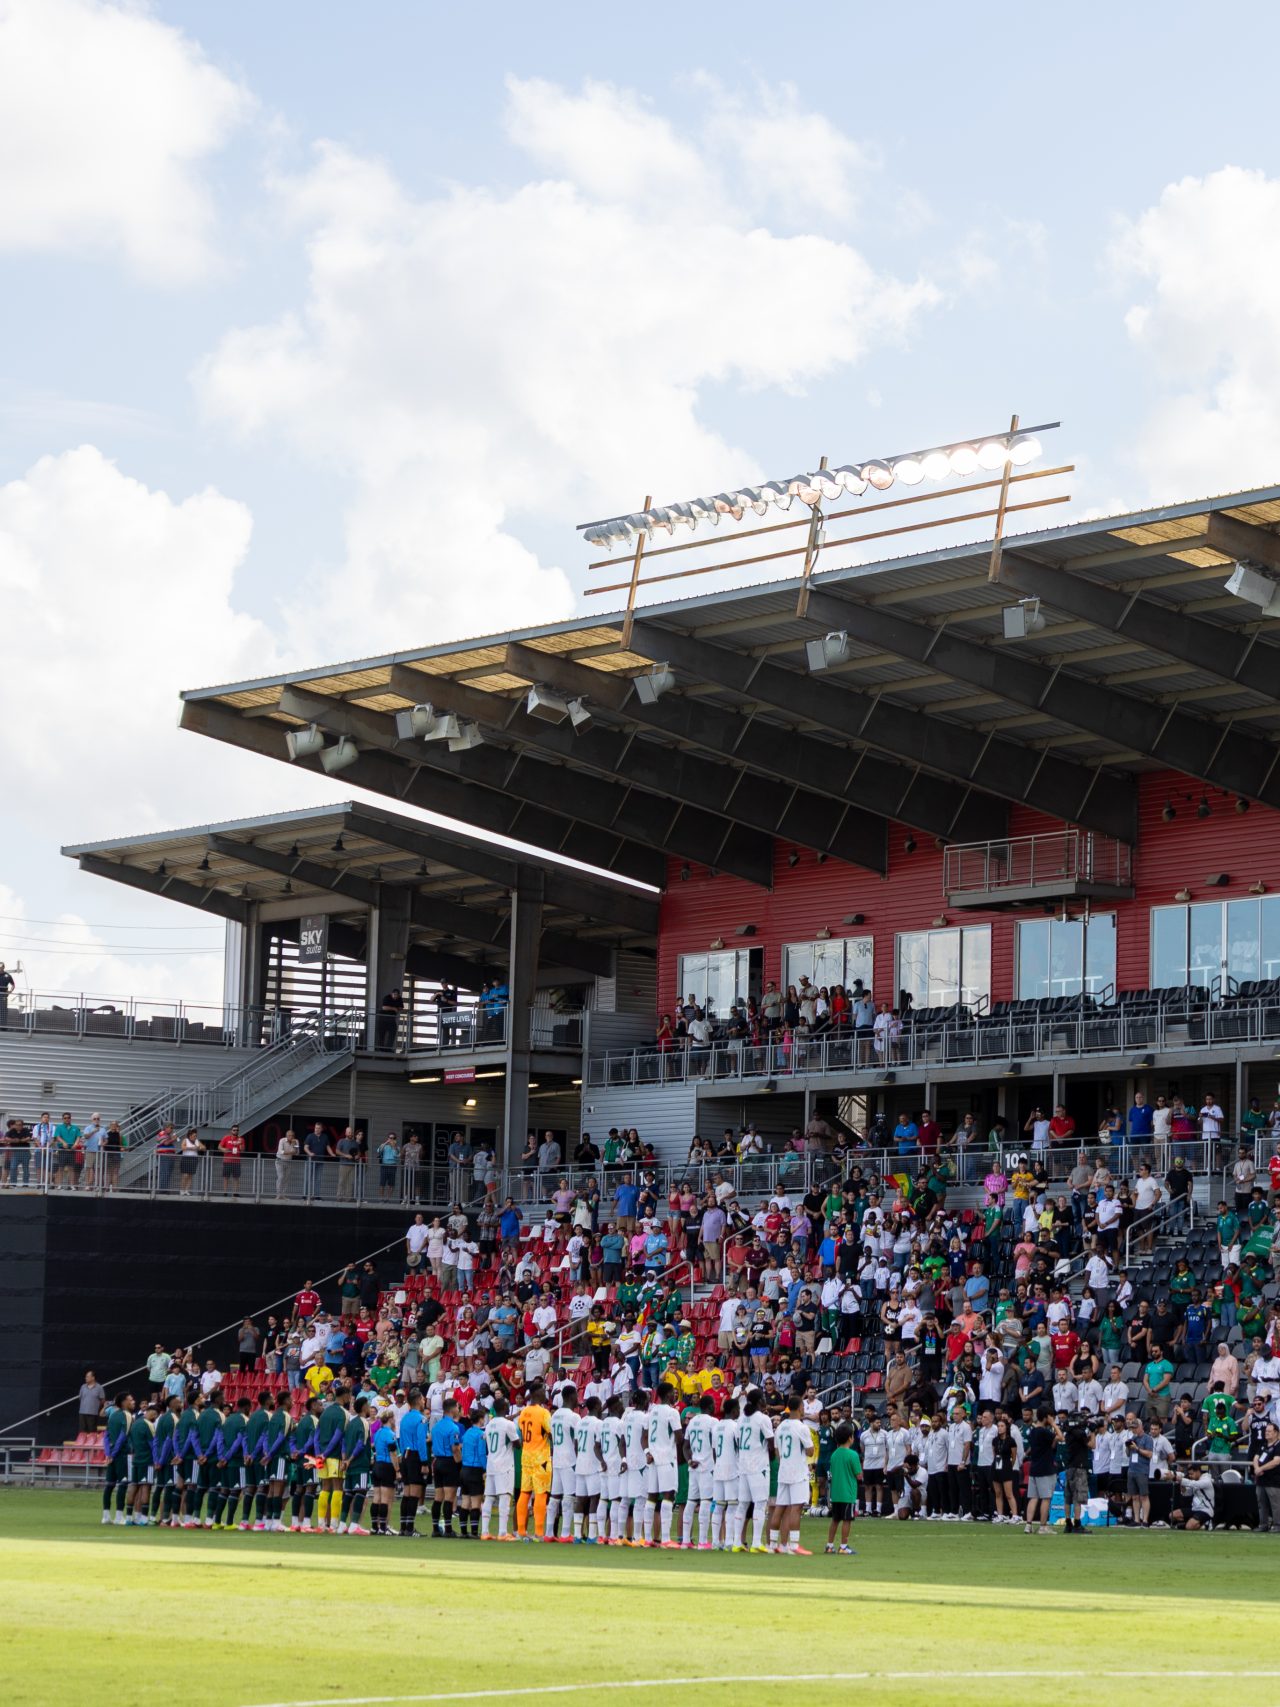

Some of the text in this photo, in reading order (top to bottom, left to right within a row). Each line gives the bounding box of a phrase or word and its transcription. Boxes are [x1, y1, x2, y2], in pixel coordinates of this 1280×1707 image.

[301, 930, 322, 945] SKY
[306, 945, 321, 955] suite
[442, 1015, 471, 1025] SUITE LEVEL
[521, 1421, 533, 1443] 16
[553, 1424, 563, 1445] 19
[578, 1430, 587, 1452] 21
[650, 1420, 658, 1442] 2
[690, 1430, 703, 1452] 25
[739, 1427, 752, 1450] 12
[489, 1432, 498, 1453] 10
[601, 1431, 610, 1454] 15
[779, 1435, 792, 1458] 13
